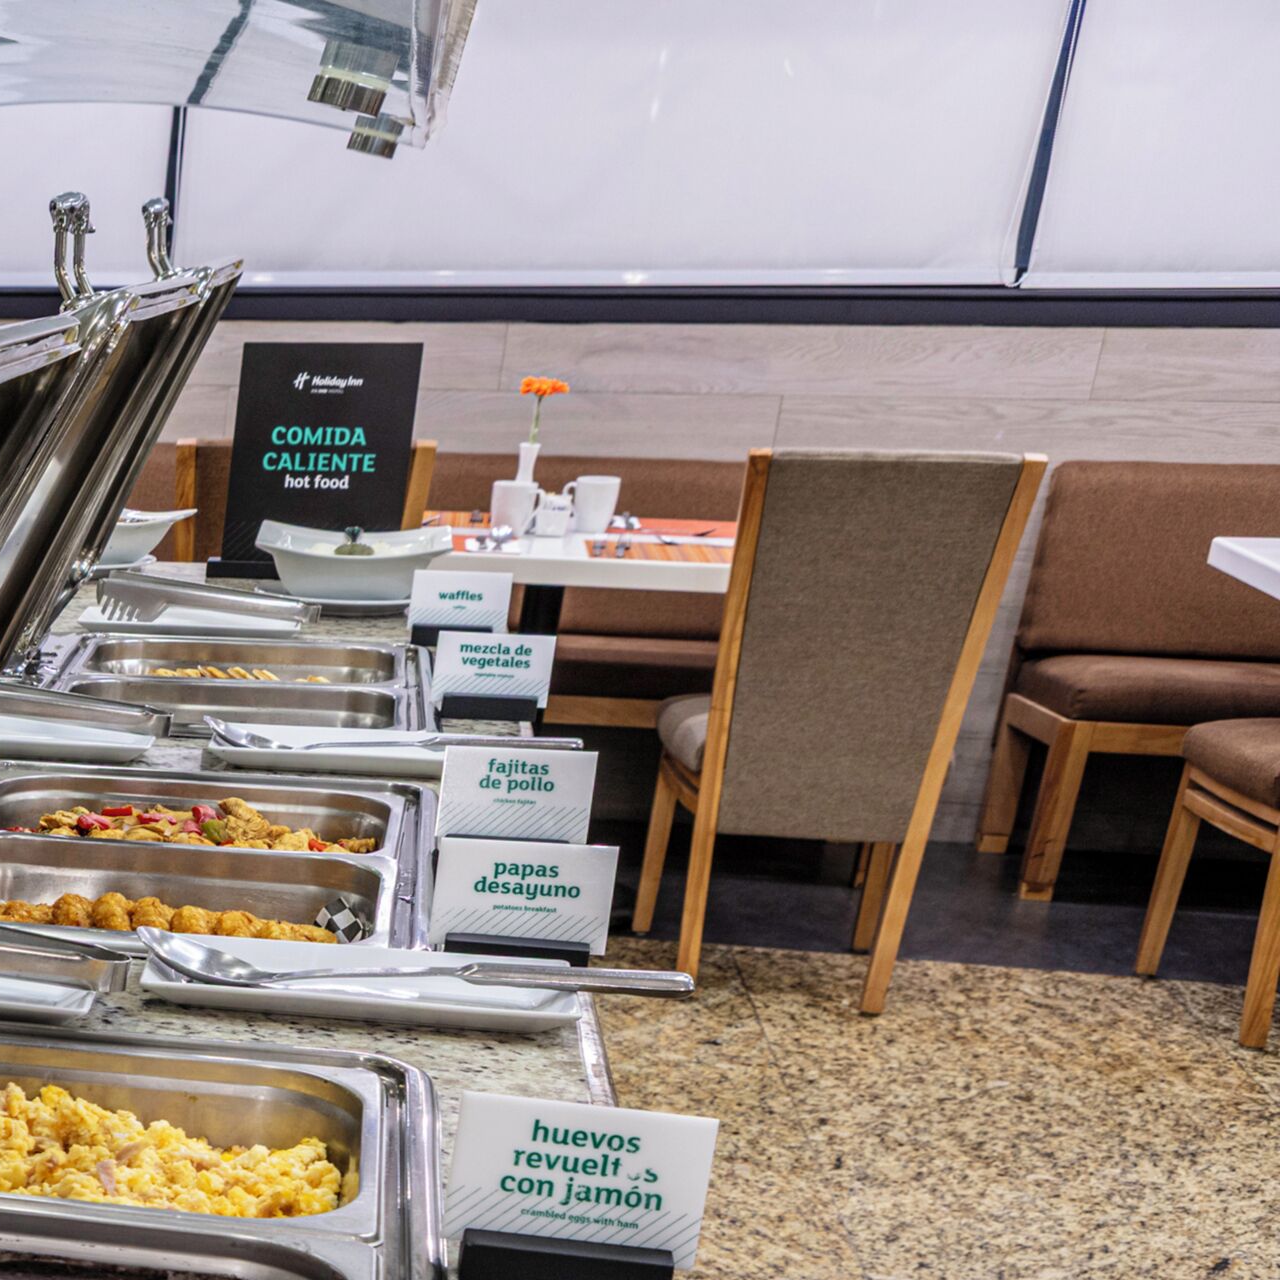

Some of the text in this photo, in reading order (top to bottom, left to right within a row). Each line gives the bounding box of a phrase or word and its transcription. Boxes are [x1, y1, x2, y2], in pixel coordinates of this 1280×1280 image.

[311, 375, 364, 388] Holiday Inn
[271, 425, 367, 447] COMIDA
[262, 451, 377, 473] CALIENTE
[284, 474, 350, 490] hot food
[438, 590, 483, 602] waffles
[460, 643, 533, 657] mezcla de
[461, 656, 531, 670] vegetales
[488, 758, 550, 778] fajitas
[479, 775, 555, 794] de pollo
[493, 861, 560, 881] papas
[473, 876, 582, 901] desayuno
[531, 1118, 642, 1154] huevos
[499, 1174, 664, 1212] con jamón
[568, 1213, 592, 1224] eggs
[593, 1216, 615, 1227] with
[616, 1219, 640, 1231] ham
